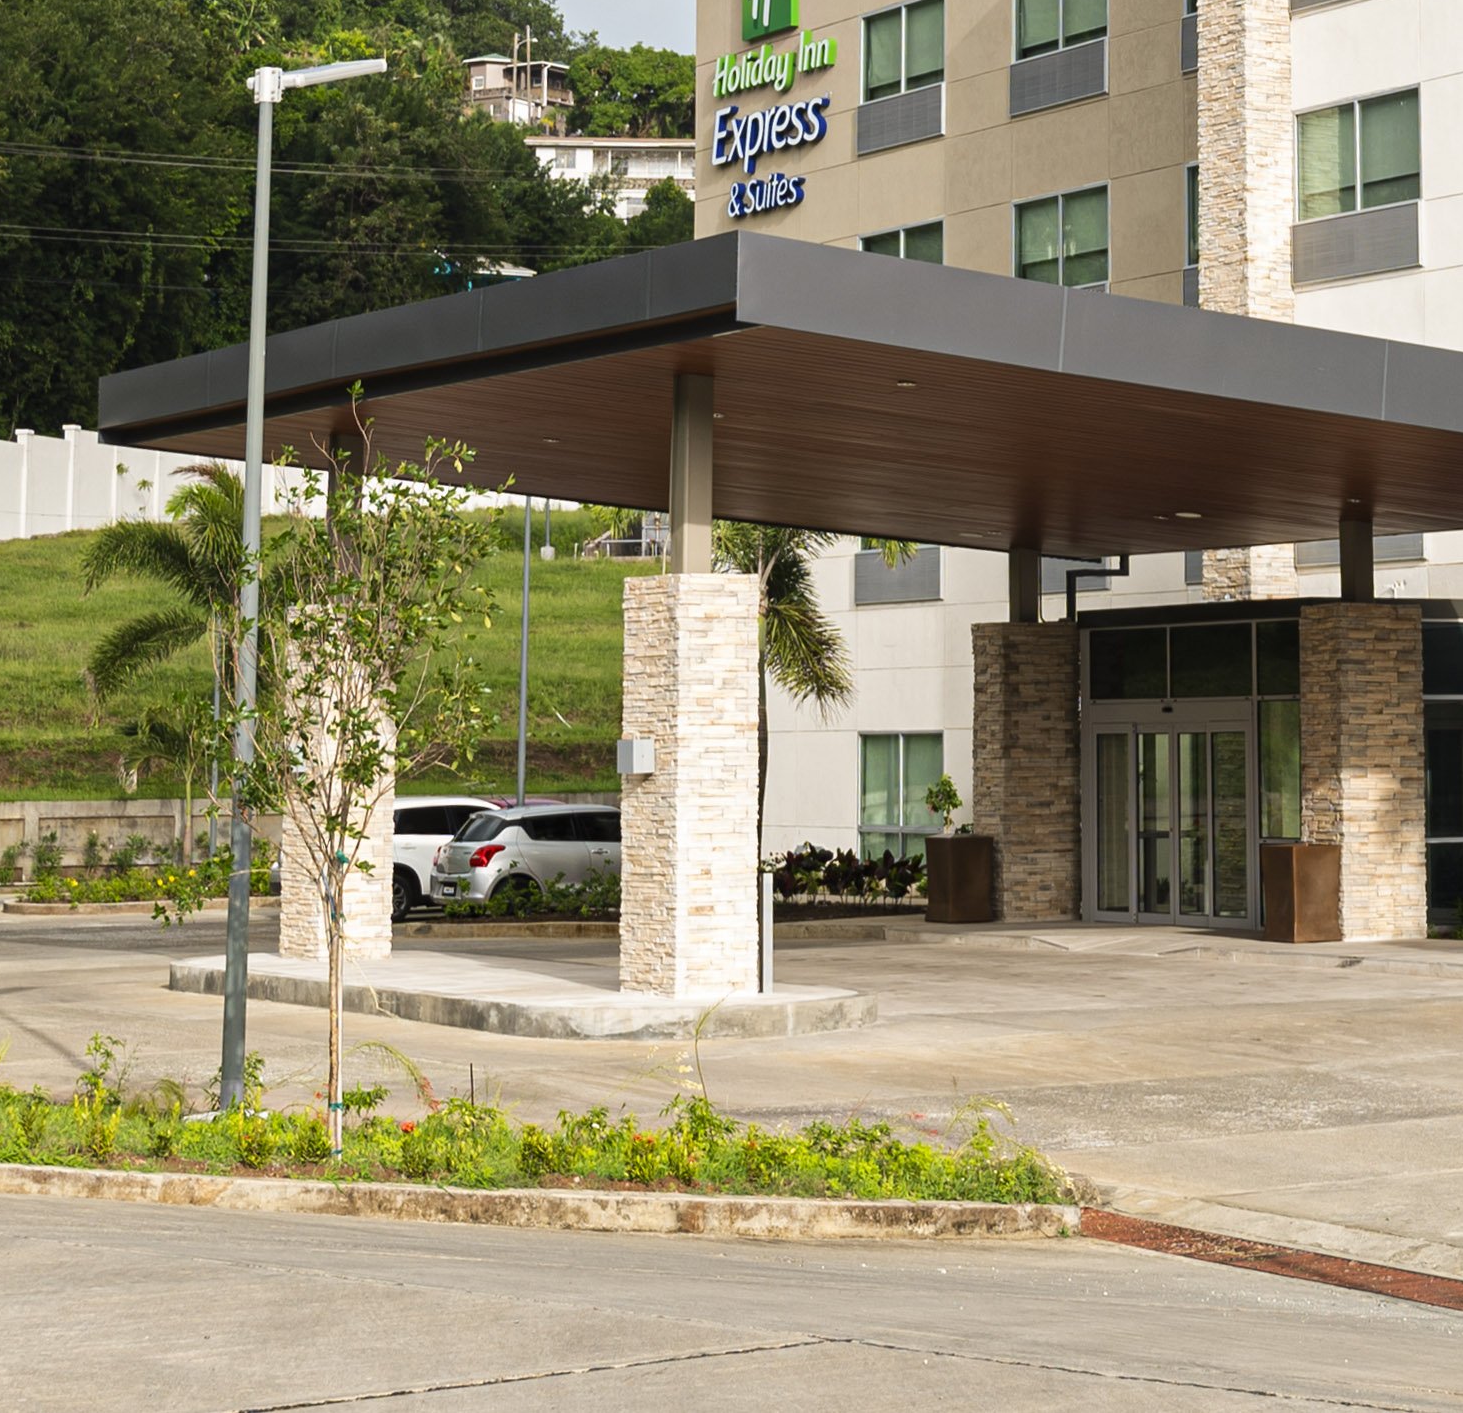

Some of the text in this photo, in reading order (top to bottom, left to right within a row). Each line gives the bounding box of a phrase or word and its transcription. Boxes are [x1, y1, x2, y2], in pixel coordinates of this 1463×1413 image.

[712, 30, 833, 98] Holiday Inn
[712, 97, 826, 174] Express
[728, 173, 802, 218] & Suites
